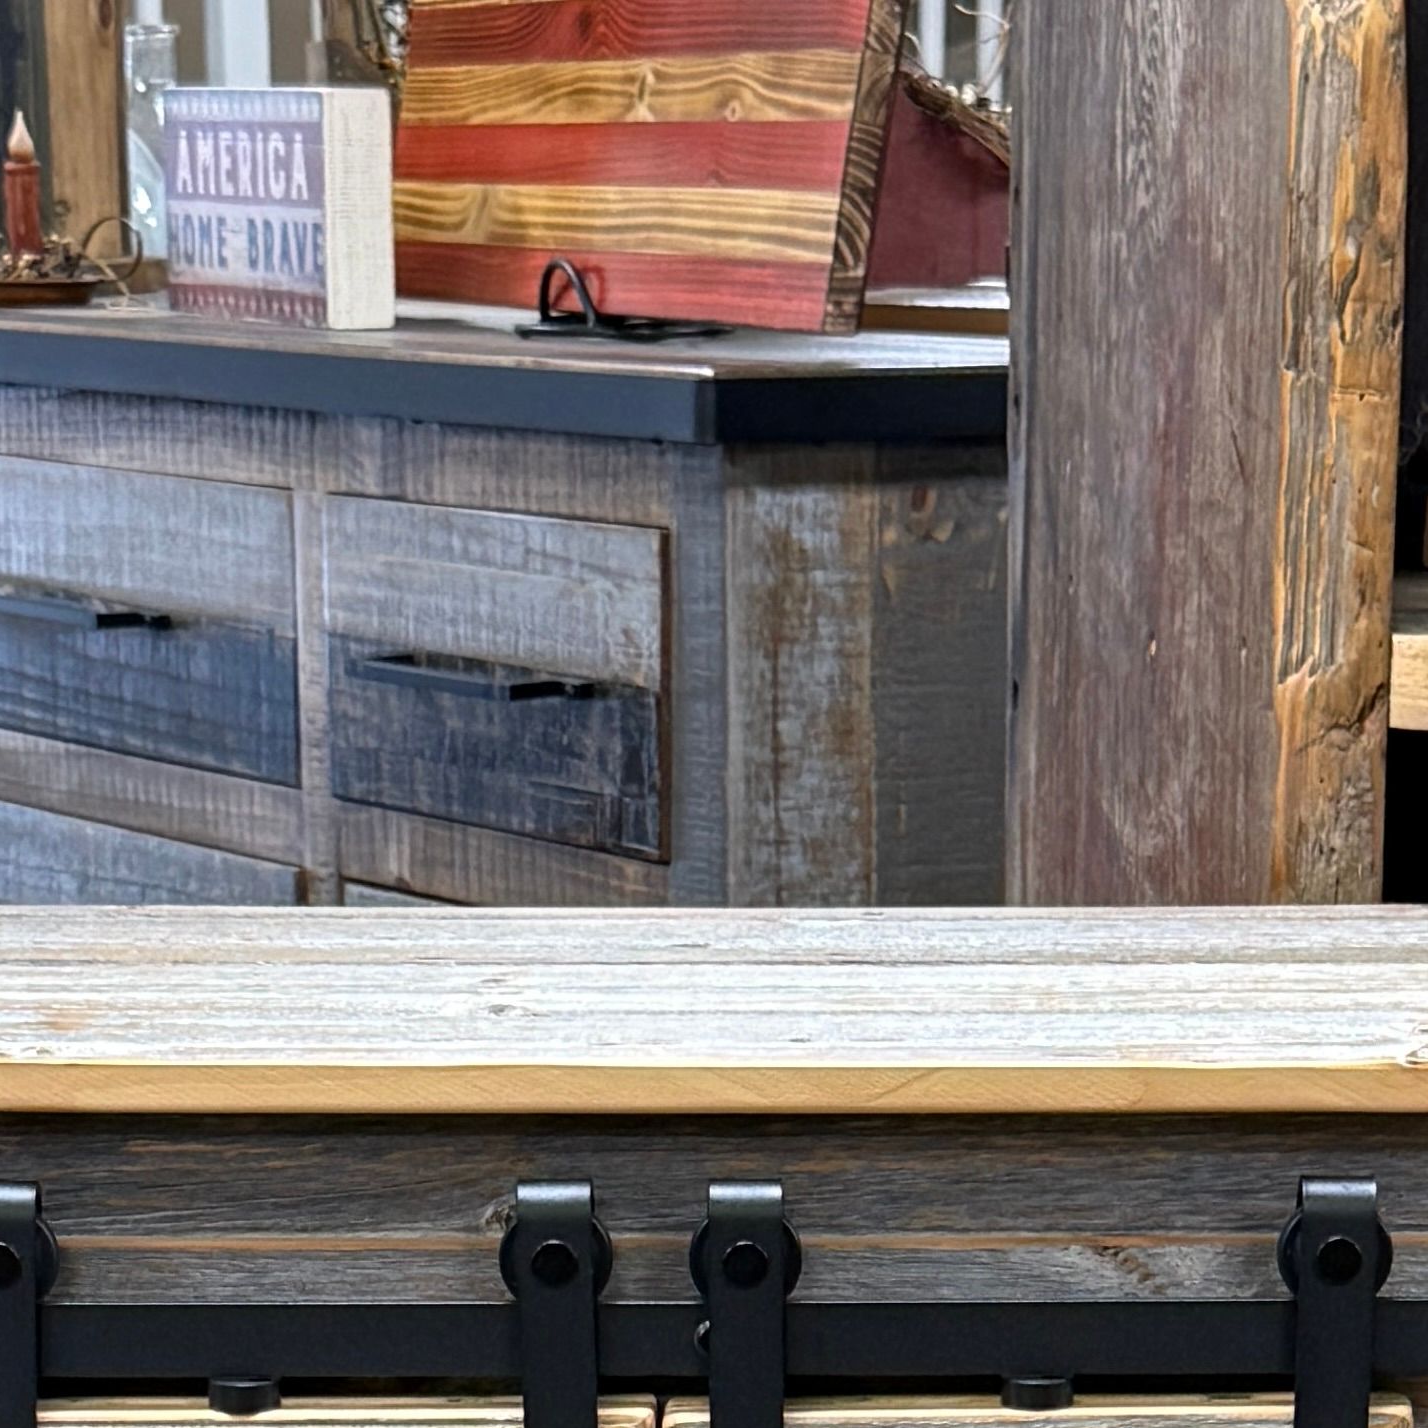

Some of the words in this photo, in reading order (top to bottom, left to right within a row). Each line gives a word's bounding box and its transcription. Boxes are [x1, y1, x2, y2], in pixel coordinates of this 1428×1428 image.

[176, 129, 309, 200] AMERICA
[167, 213, 229, 269] HOME
[247, 217, 325, 276] BRAVE
